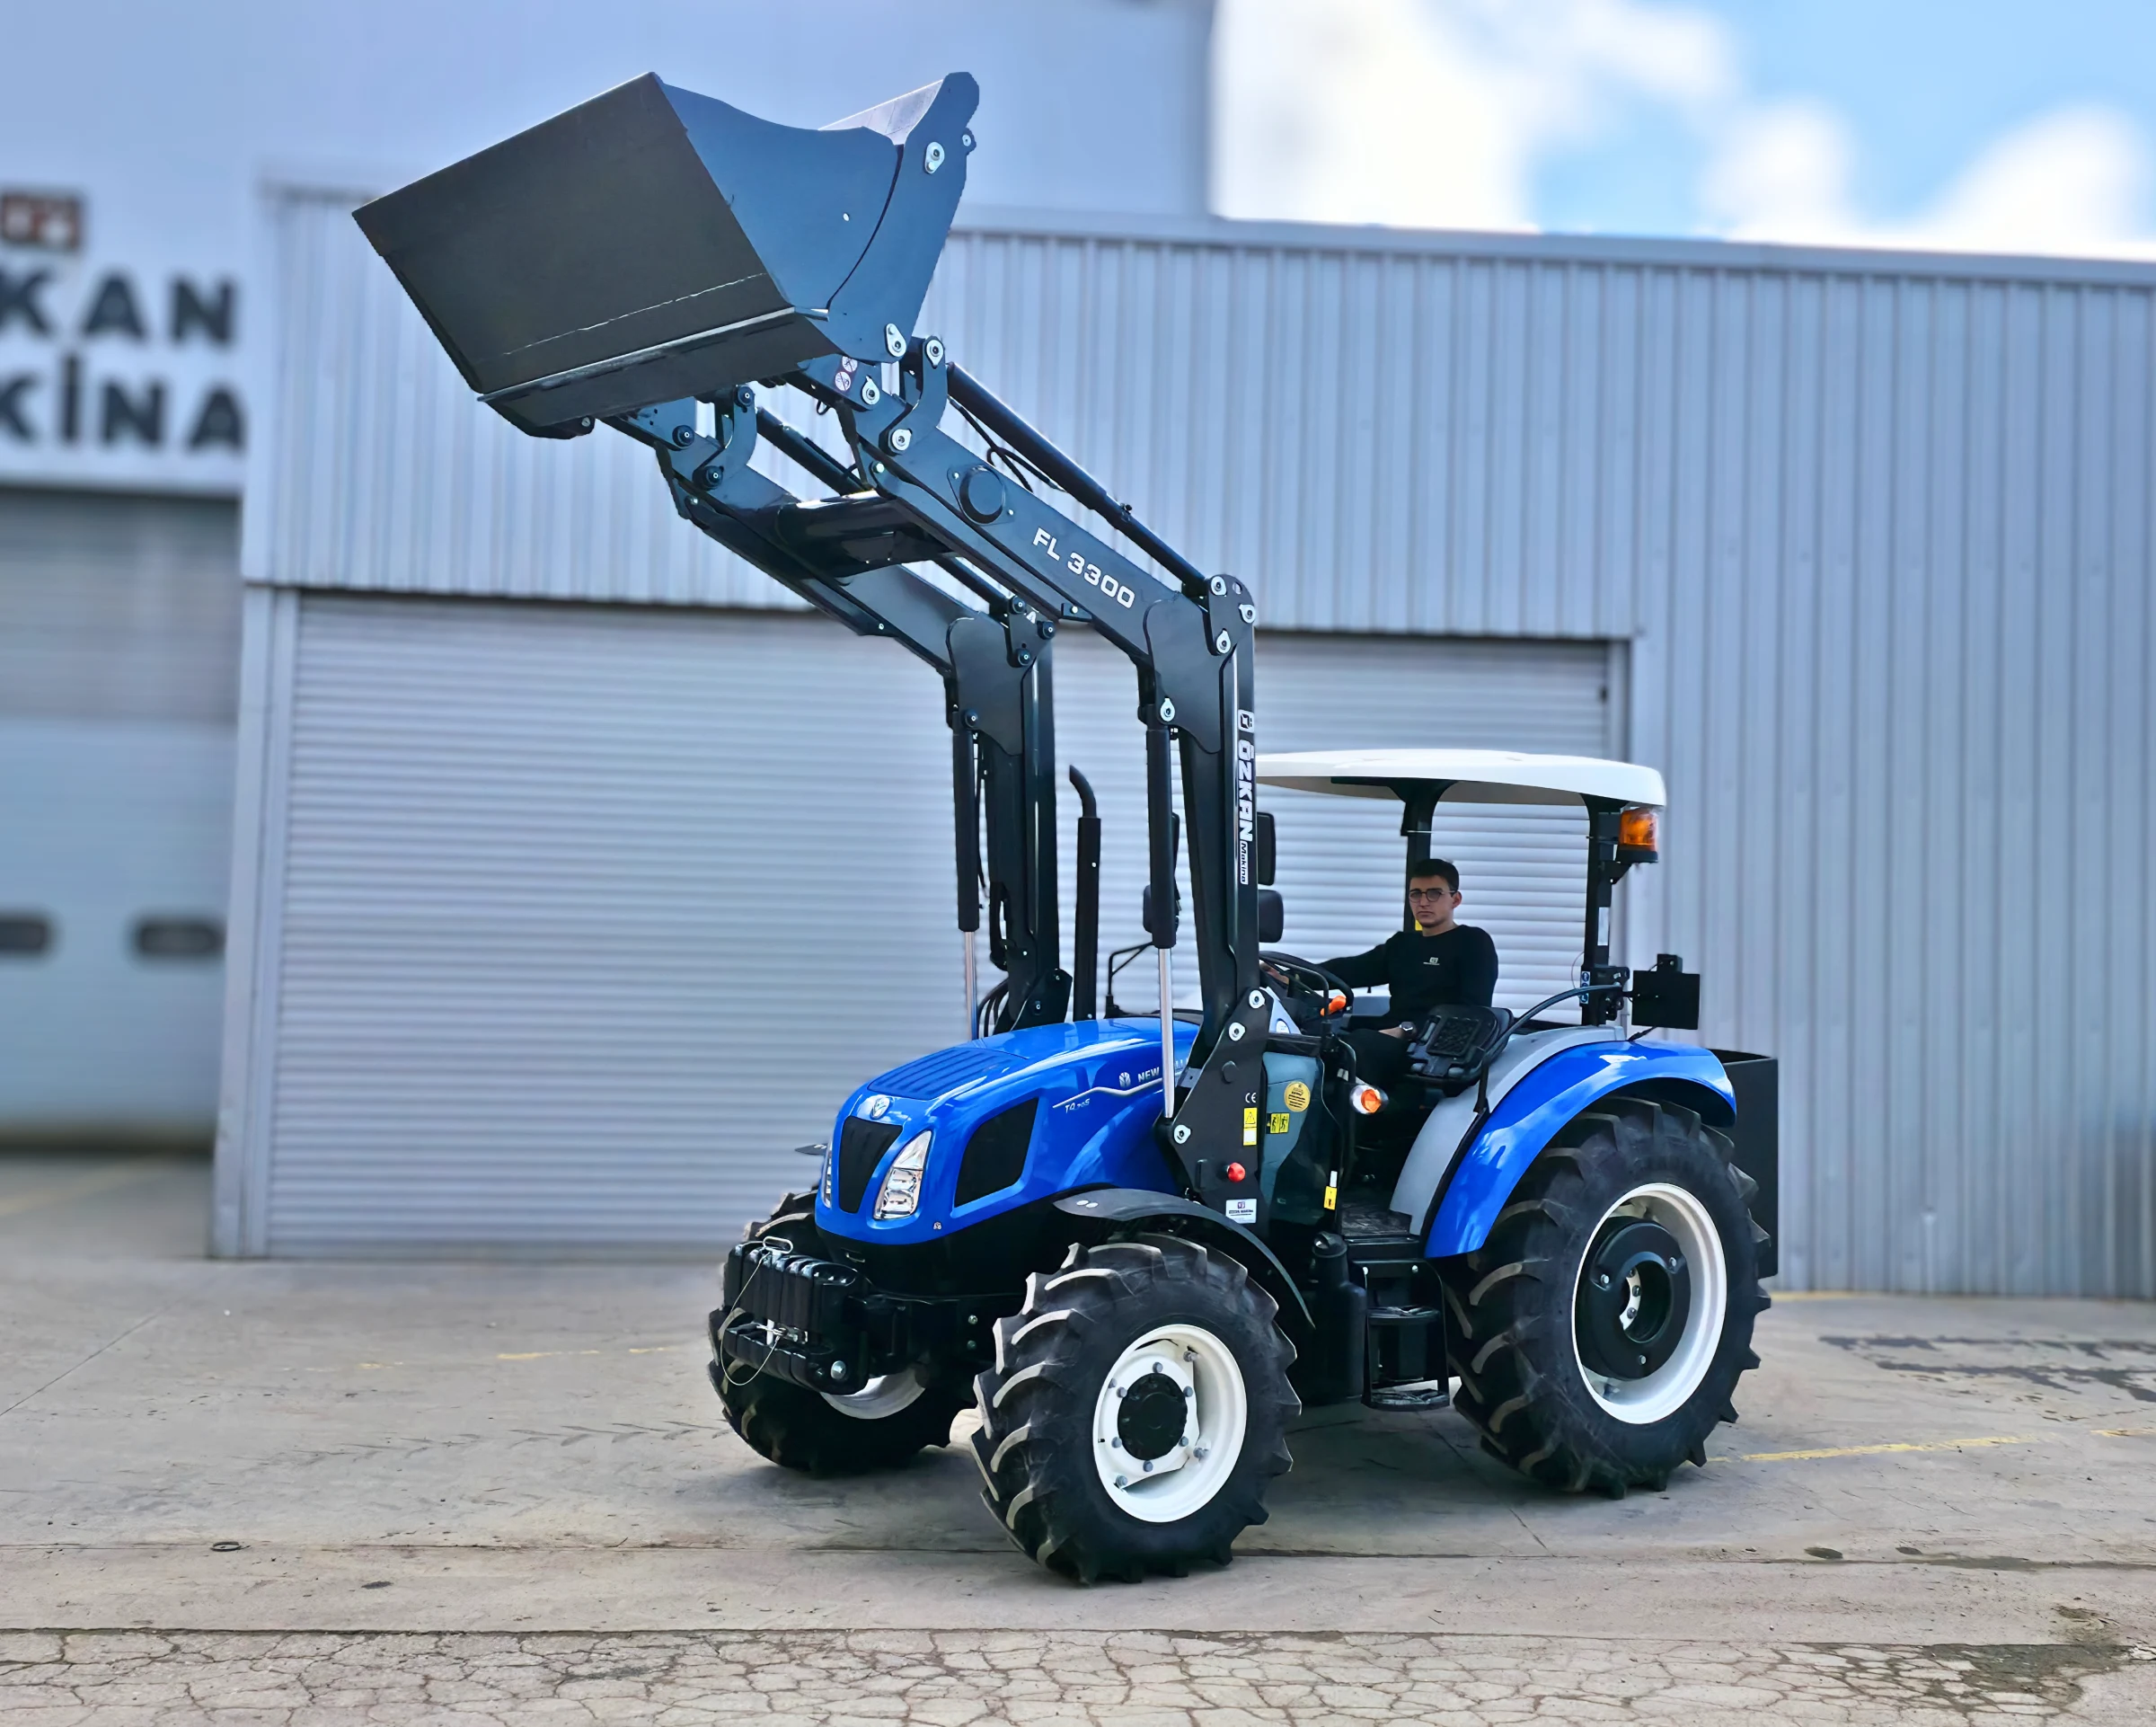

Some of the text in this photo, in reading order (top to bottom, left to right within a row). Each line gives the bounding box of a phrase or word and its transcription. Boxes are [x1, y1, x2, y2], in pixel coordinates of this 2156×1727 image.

[1033, 527, 1135, 609] FL 3300
[1238, 739, 1254, 842] ÖZKAN
[1137, 1067, 1160, 1083] NEW
